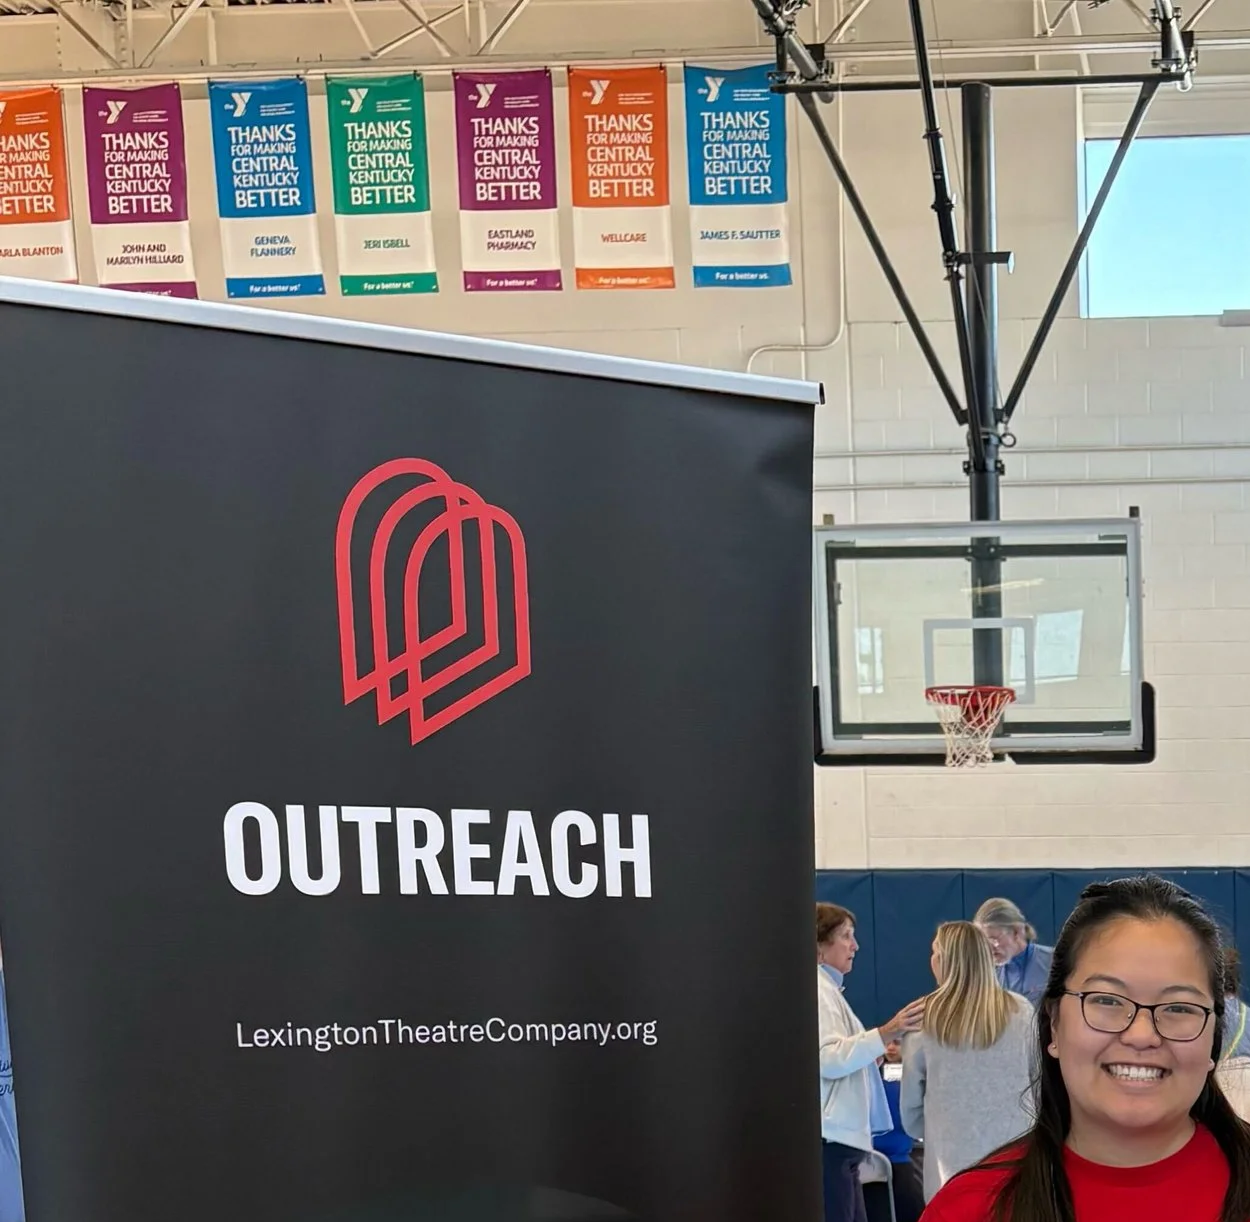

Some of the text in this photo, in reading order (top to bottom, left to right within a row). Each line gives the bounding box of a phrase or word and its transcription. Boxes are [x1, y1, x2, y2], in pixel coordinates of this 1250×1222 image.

[470, 116, 540, 136] THANKS
[584, 114, 653, 132] THANKS
[700, 110, 770, 129] THANKS
[227, 123, 296, 144] THANKS
[343, 120, 412, 140] THANKS
[587, 131, 653, 145] FOR MAKING
[703, 129, 770, 143] FOR MAKING
[101, 131, 169, 150] THANKS
[347, 139, 412, 153] FOR MAKING
[474, 135, 540, 149] FOR MAKING
[10, 150, 50, 163] MAKING
[104, 149, 168, 163] FOR MAKING
[230, 142, 296, 157] FOR MAKING
[474, 148, 541, 166] CENTRAL
[587, 145, 654, 163] CENTRAL
[703, 142, 772, 160] CENTRAL
[232, 156, 299, 175] CENTRAL
[348, 152, 414, 170] CENTRAL
[588, 161, 655, 178] KENTUCKY
[703, 159, 772, 175] KENTUCKY
[105, 162, 171, 180] CENTRAL
[233, 171, 300, 188] KENTUCKY
[349, 168, 414, 185] KENTUCKY
[475, 165, 541, 181] KENTUCKY
[106, 179, 171, 194] KENTUCKY
[476, 181, 542, 202] BETTER
[589, 178, 655, 198] BETTER
[704, 175, 773, 196] BETTER
[234, 187, 302, 209] BETTER
[351, 184, 416, 206] BETTER
[0, 195, 56, 215] ETTER
[108, 195, 173, 215] BETTER
[254, 235, 291, 246] GENEVA
[488, 229, 534, 240] EASTLAND
[601, 233, 647, 243] WELLCARE
[700, 229, 781, 241] JAMES F. SAUTTER
[22, 246, 64, 256] BLANTON
[121, 243, 166, 254] JOHN AND
[250, 246, 297, 258] FLANNERY
[363, 239, 410, 249] JERI ISBELL
[487, 240, 537, 251] PHARMACY
[106, 254, 184, 266] MARILYN HILLIARD
[486, 278, 498, 287] For
[715, 272, 728, 281] For
[735, 272, 757, 280] better
[223, 801, 652, 898] OUTREACH
[236, 1017, 658, 1052] LexingtonTheatreCompany.org
